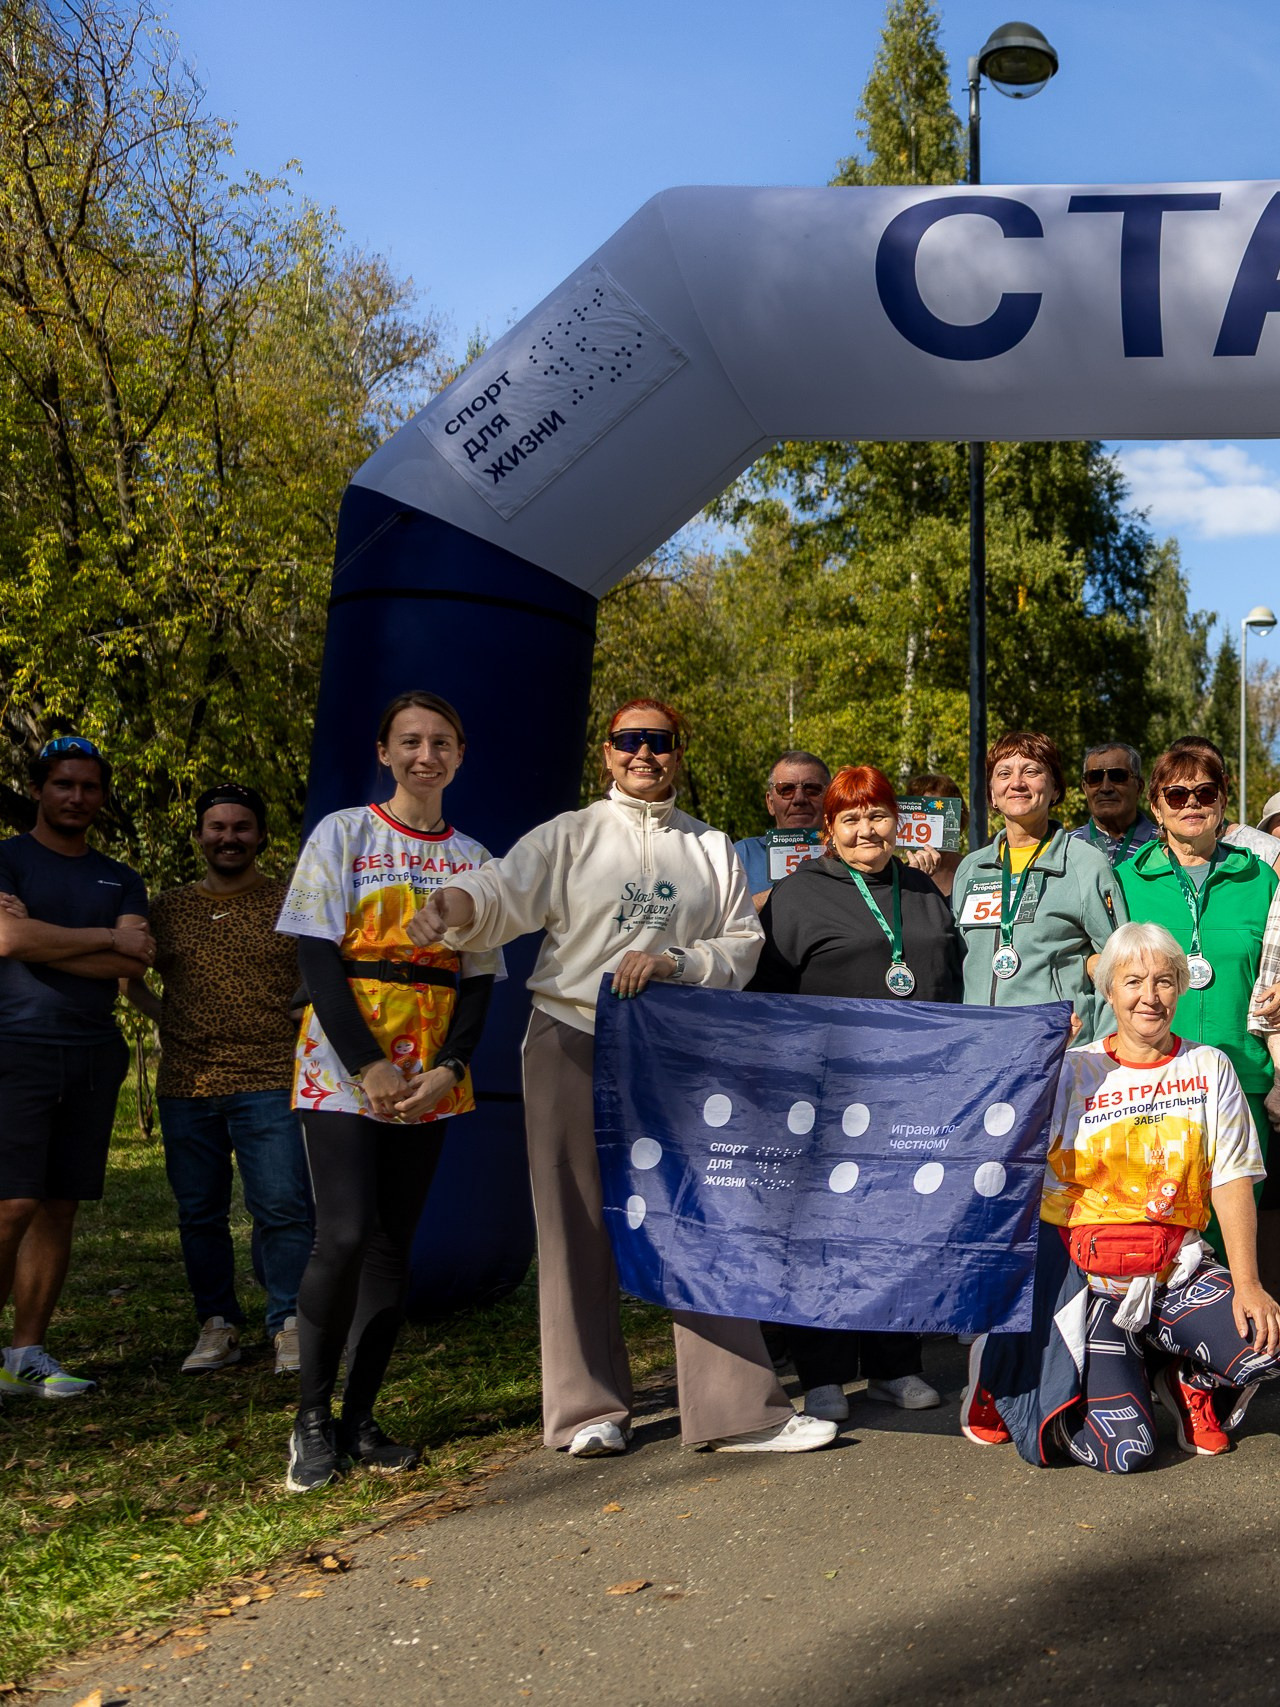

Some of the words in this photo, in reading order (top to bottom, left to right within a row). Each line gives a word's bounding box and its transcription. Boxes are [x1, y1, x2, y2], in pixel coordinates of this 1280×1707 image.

[444, 370, 512, 436] спорт
[462, 413, 511, 464] для
[772, 835, 778, 843] 5
[897, 822, 932, 844] 49
[352, 853, 395, 873] БЕЗ
[621, 883, 654, 902] Slow
[978, 884, 1002, 892] городо
[628, 904, 676, 917] Down!
[1084, 1091, 1123, 1112] БЕЗ
[1128, 1075, 1209, 1102] ГРАНИЦ
[1084, 1093, 1208, 1124] БЛАГОТВОРИТЕЛЬНЫЙ
[1133, 1113, 1168, 1126] ЗАБЕГ
[891, 1123, 939, 1138] играем
[941, 1122, 961, 1135] по-
[710, 1141, 749, 1155] спорт
[889, 1136, 949, 1151] честному
[707, 1157, 733, 1171] для
[703, 1174, 746, 1188] жизни
